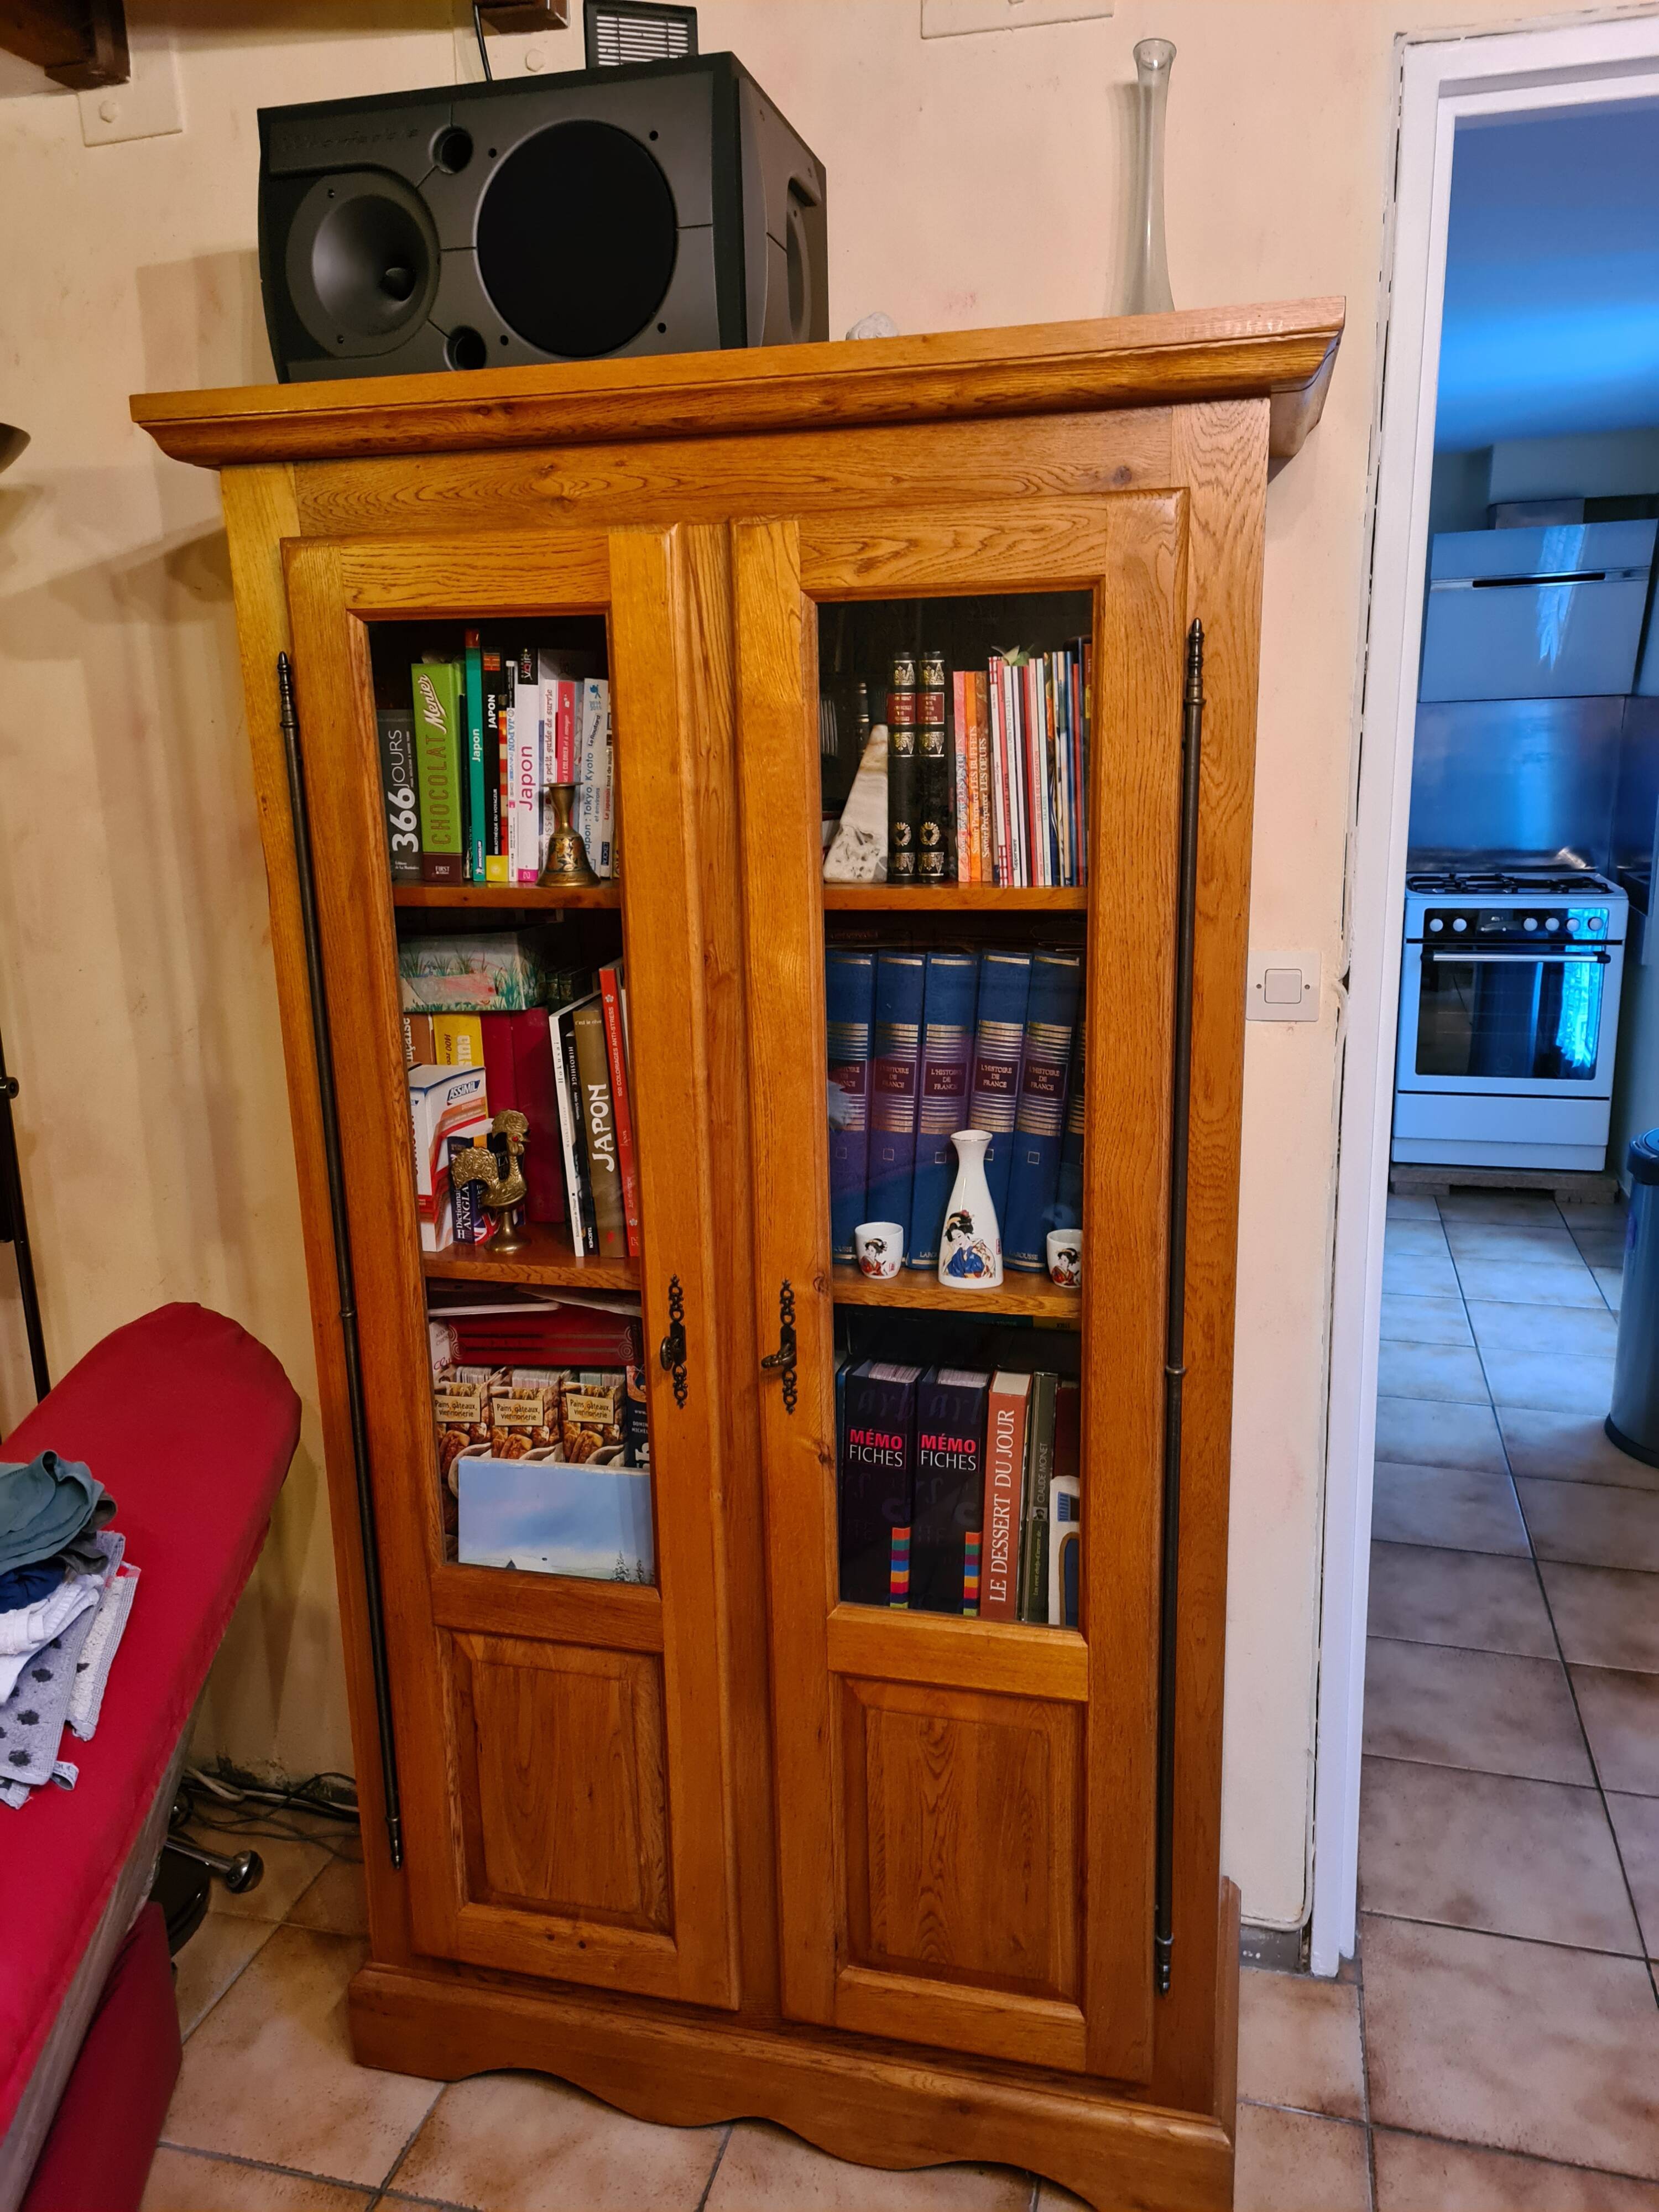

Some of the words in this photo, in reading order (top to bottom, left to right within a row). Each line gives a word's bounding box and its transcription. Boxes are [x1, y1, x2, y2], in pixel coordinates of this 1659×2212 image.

[418, 673, 447, 735] Menier
[488, 694, 498, 728] JAPON
[548, 716, 553, 728] de
[589, 715, 601, 741] Routard
[471, 728, 482, 762] Japon
[545, 730, 554, 753] guide
[969, 725, 977, 770] BUFFETS
[388, 729, 410, 789] JOURS
[545, 755, 553, 777] petit
[585, 752, 594, 781] Kyoto
[425, 734, 451, 846] CHOCOLAT
[519, 746, 536, 811] Japon
[970, 771, 978, 790] LES
[979, 773, 988, 791] LES
[584, 784, 594, 815] Tokyo,
[980, 794, 990, 830] Préparer
[388, 787, 419, 853] 366
[604, 812, 609, 821] Le
[584, 824, 593, 855] Japon
[982, 830, 990, 858] Savoir
[608, 1006, 618, 1046] ANTI-STRESS
[554, 1042, 564, 1083] Hokusai
[568, 1046, 578, 1086] HIROSHIGE
[613, 1047, 622, 1087] COLORIAGES
[981, 1064, 1013, 1074] L'HISTOIRE
[1029, 1066, 1061, 1077] L'HISTOIRE
[983, 1080, 1008, 1088] FRANCE
[1030, 1082, 1055, 1091] FRANCE
[587, 1083, 615, 1172] JAPON
[461, 1186, 472, 1230] ANGLA
[439, 1409, 474, 1417] viennoiserie
[452, 1401, 478, 1411] gâteaux,
[514, 1405, 540, 1414] gâteaux,
[574, 1408, 608, 1419] viennoiserie
[586, 1401, 611, 1412] gâteaux,
[850, 1428, 903, 1450] MÉMO
[921, 1433, 977, 1454] MÉMO
[996, 1410, 1015, 1458] JOUR
[849, 1444, 903, 1467] FICHES
[921, 1450, 977, 1472] FICHES
[1039, 1442, 1048, 1473] MONET
[995, 1462, 1012, 1488] DU
[1037, 1474, 1046, 1503] CLAUDE
[991, 1494, 1011, 1574] DESSERT
[989, 1579, 1006, 1603] LE
